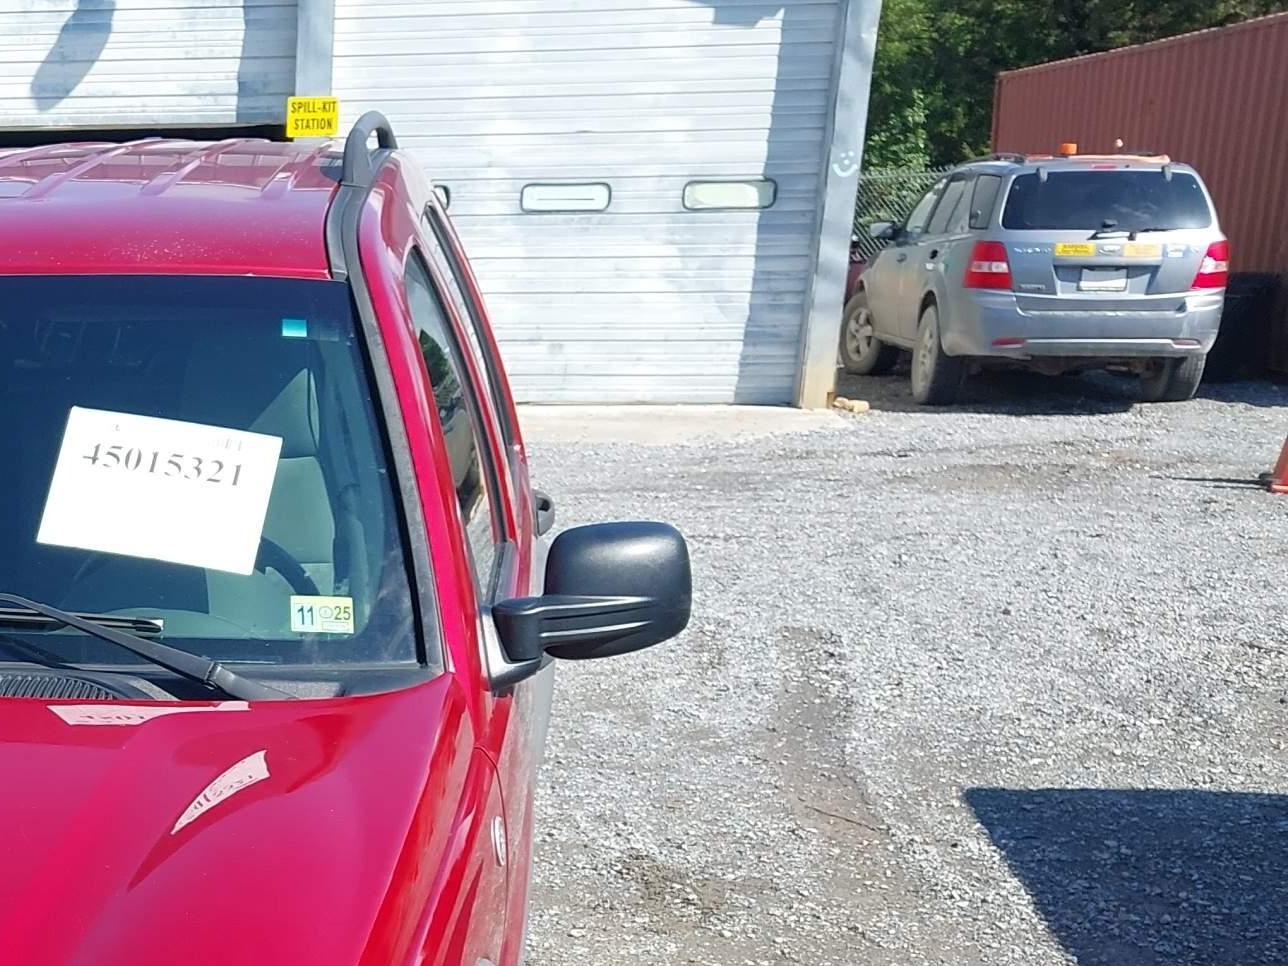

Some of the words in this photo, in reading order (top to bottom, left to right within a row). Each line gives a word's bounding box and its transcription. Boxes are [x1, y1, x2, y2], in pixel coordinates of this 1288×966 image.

[291, 101, 336, 113] SPILL-KIT
[294, 118, 333, 130] STATION
[82, 443, 242, 486] 45015321
[297, 605, 314, 626] 11
[334, 605, 351, 621] 25
